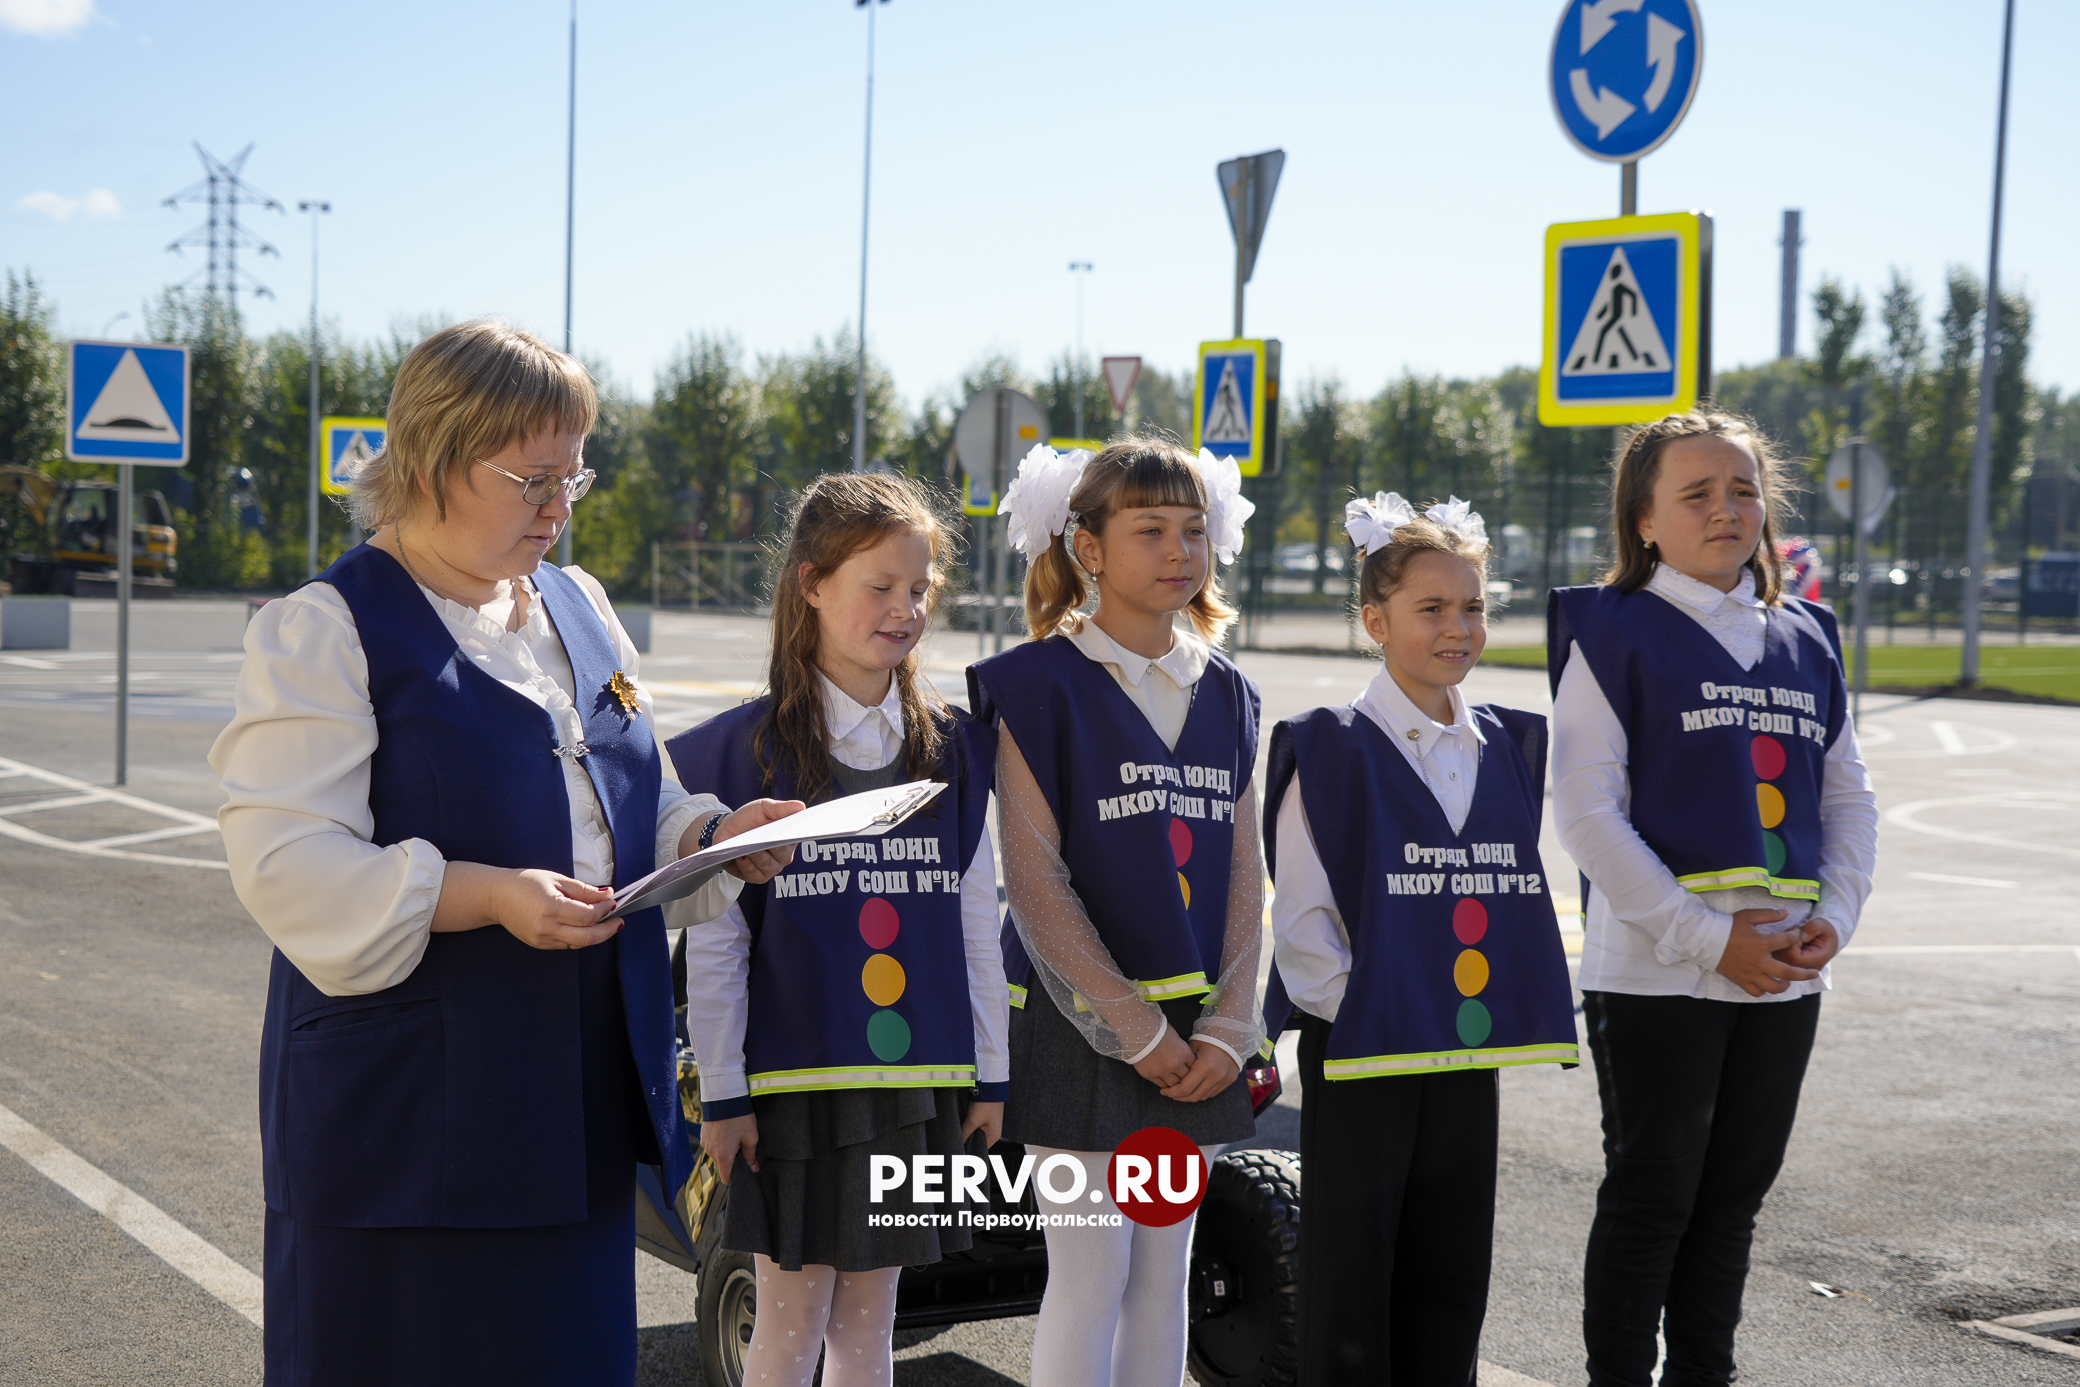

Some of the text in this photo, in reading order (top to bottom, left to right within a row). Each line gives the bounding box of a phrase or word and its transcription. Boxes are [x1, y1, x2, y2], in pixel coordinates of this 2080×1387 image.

[1701, 682, 1767, 707] Отряд
[1681, 707, 1745, 732] МКОУ
[1748, 710, 1794, 735] СОШ
[1120, 762, 1231, 795] Отряд ЮИД
[1097, 790, 1235, 824] МКОУ СОШ №1
[801, 838, 941, 865] Отряд ЮИД
[1404, 843, 1517, 868] Отряд ЮИД
[774, 870, 850, 898] МКОУ
[858, 870, 909, 894] СОШ
[1386, 873, 1541, 895] МКОУ СОШ №12
